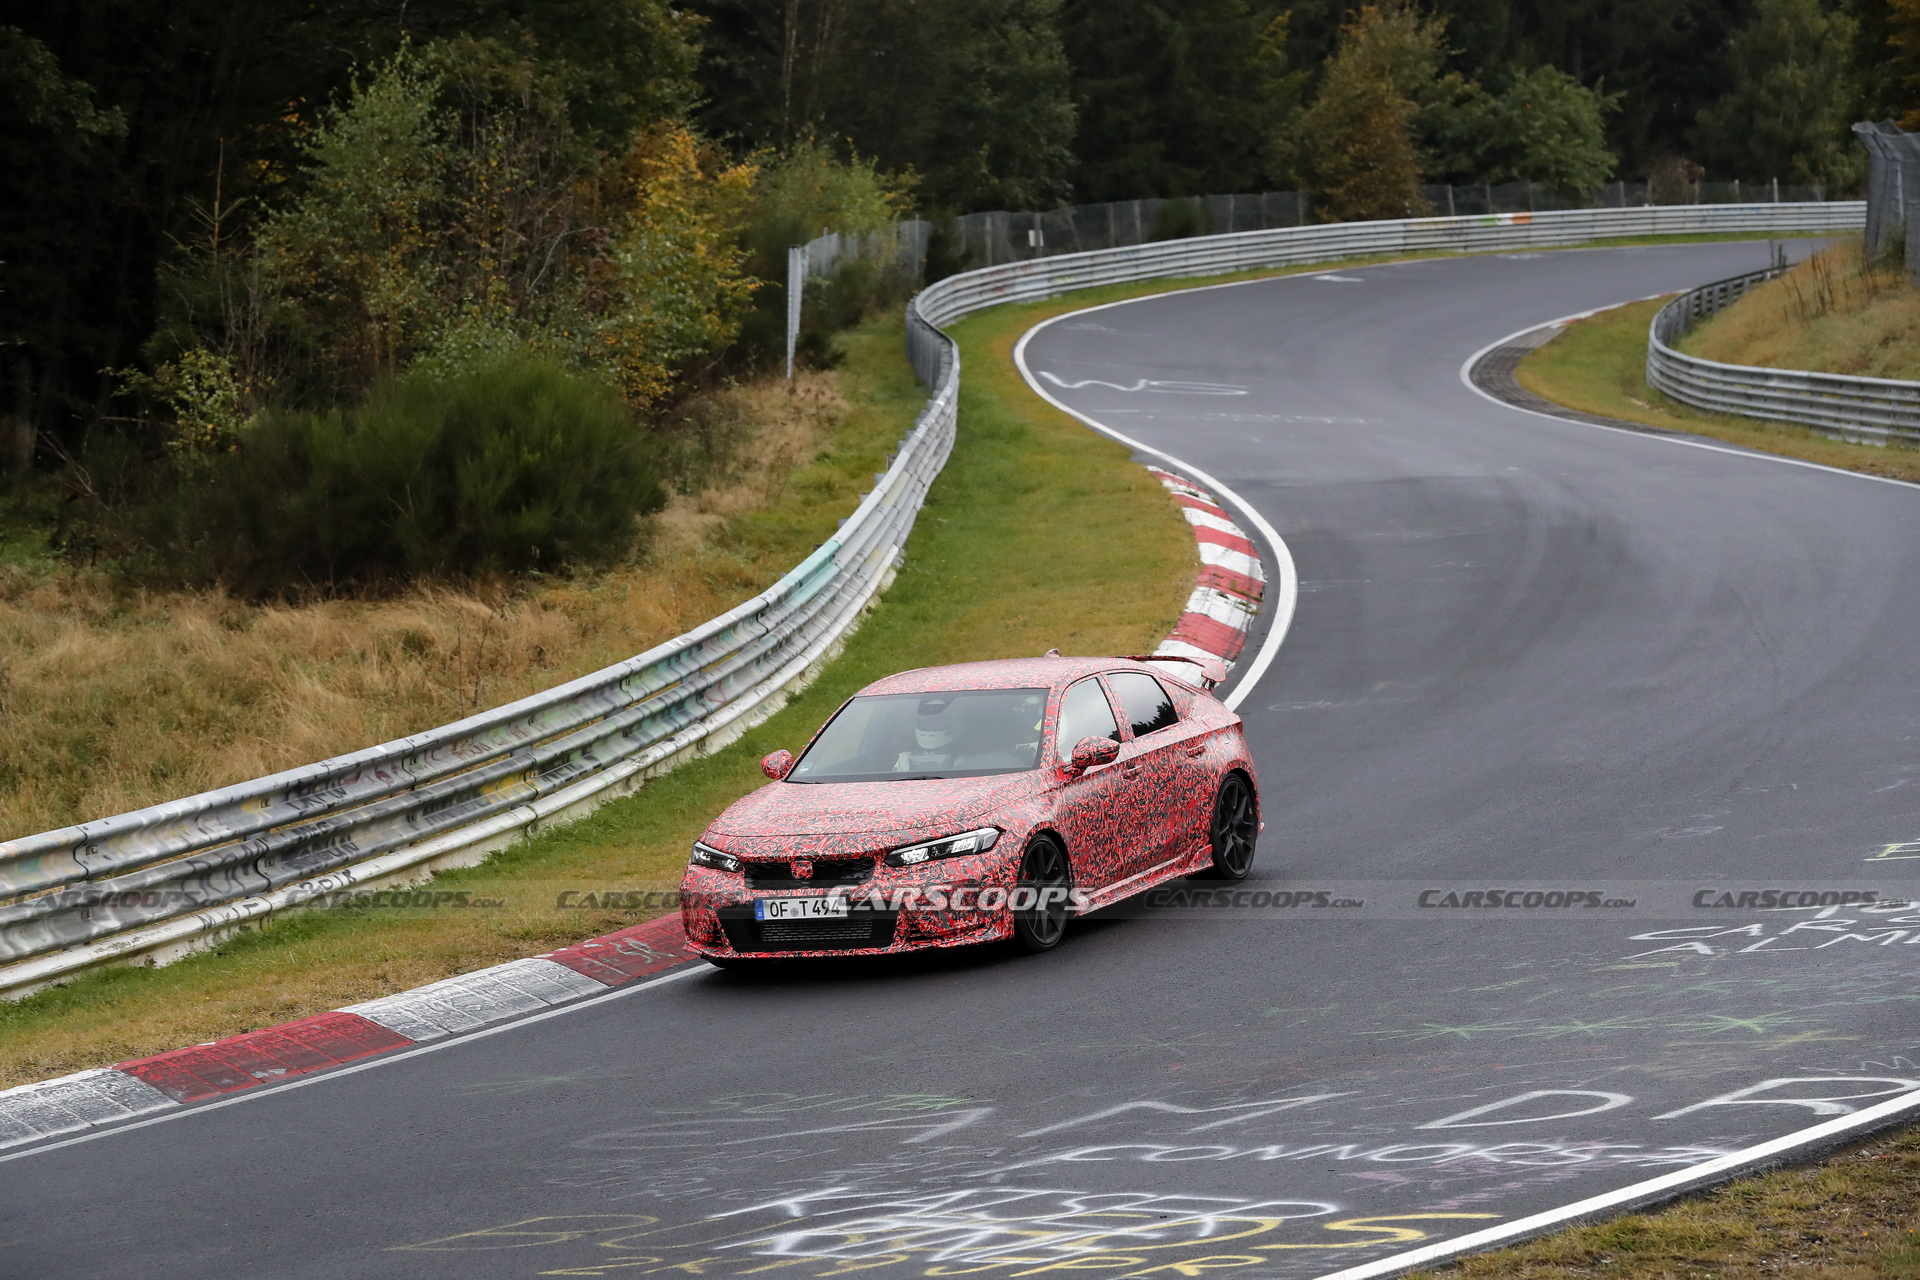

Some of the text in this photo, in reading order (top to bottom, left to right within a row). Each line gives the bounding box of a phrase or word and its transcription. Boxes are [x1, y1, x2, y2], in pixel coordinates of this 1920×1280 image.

[769, 900, 841, 918] OF T 494
[924, 1254, 1267, 1278] JPR
